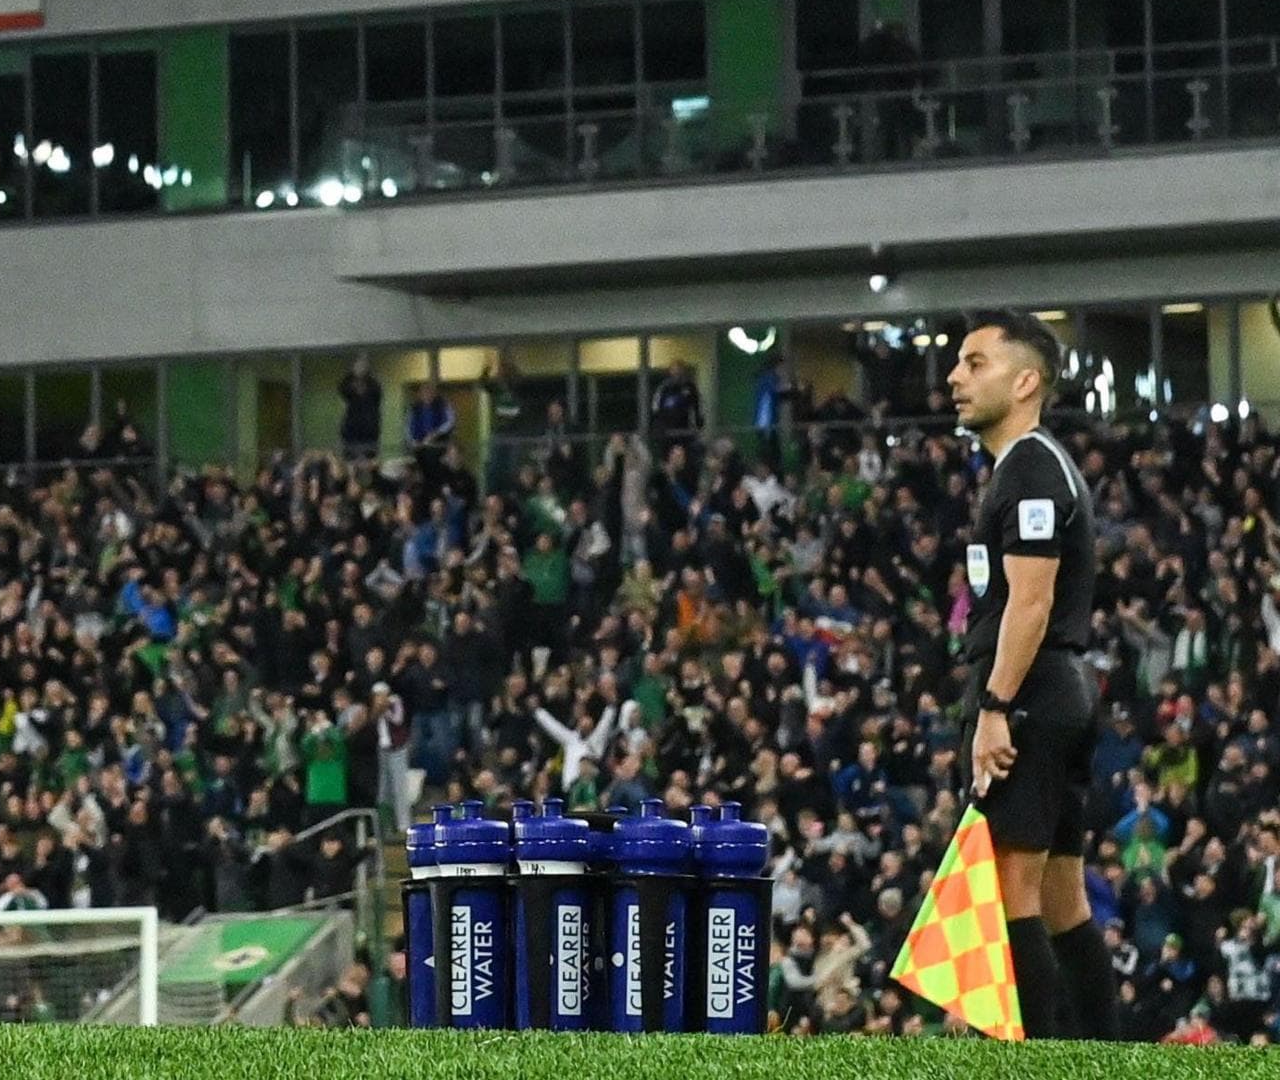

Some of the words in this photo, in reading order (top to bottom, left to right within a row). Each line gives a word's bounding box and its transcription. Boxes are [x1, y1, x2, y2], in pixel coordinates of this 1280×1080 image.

[452, 912, 468, 1010] CLEARER
[474, 921, 494, 1001] WATER
[562, 911, 579, 1010] CLEARER
[711, 914, 731, 1013] CLEARER
[736, 924, 756, 1004] WATER
